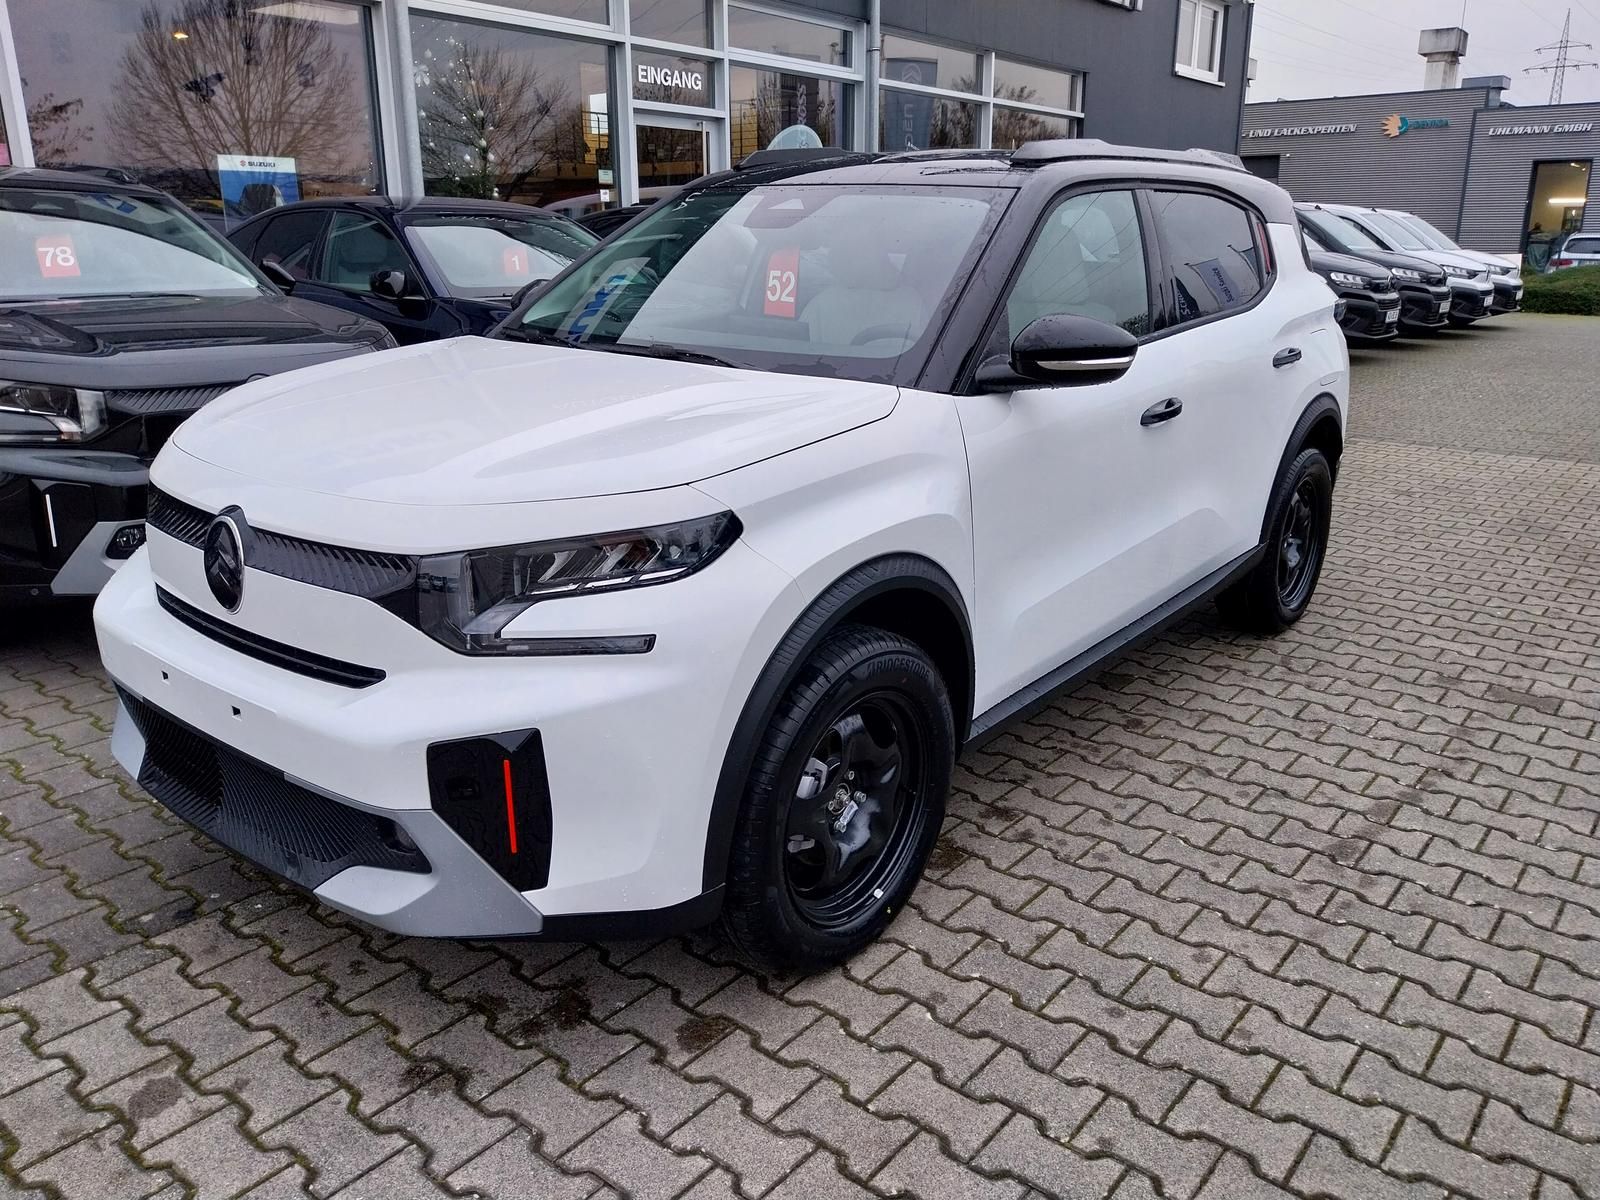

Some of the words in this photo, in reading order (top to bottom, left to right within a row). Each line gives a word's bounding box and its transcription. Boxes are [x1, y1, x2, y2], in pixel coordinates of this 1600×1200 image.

[638, 65, 702, 90] EINGANG
[1249, 129, 1272, 138] UND
[1273, 123, 1358, 137] LACKEXPERTEN
[1488, 125, 1551, 136] UHLMANN
[1553, 123, 1593, 133] GMBH
[38, 246, 75, 267] 78
[511, 255, 520, 271] 1
[767, 270, 796, 303] 52
